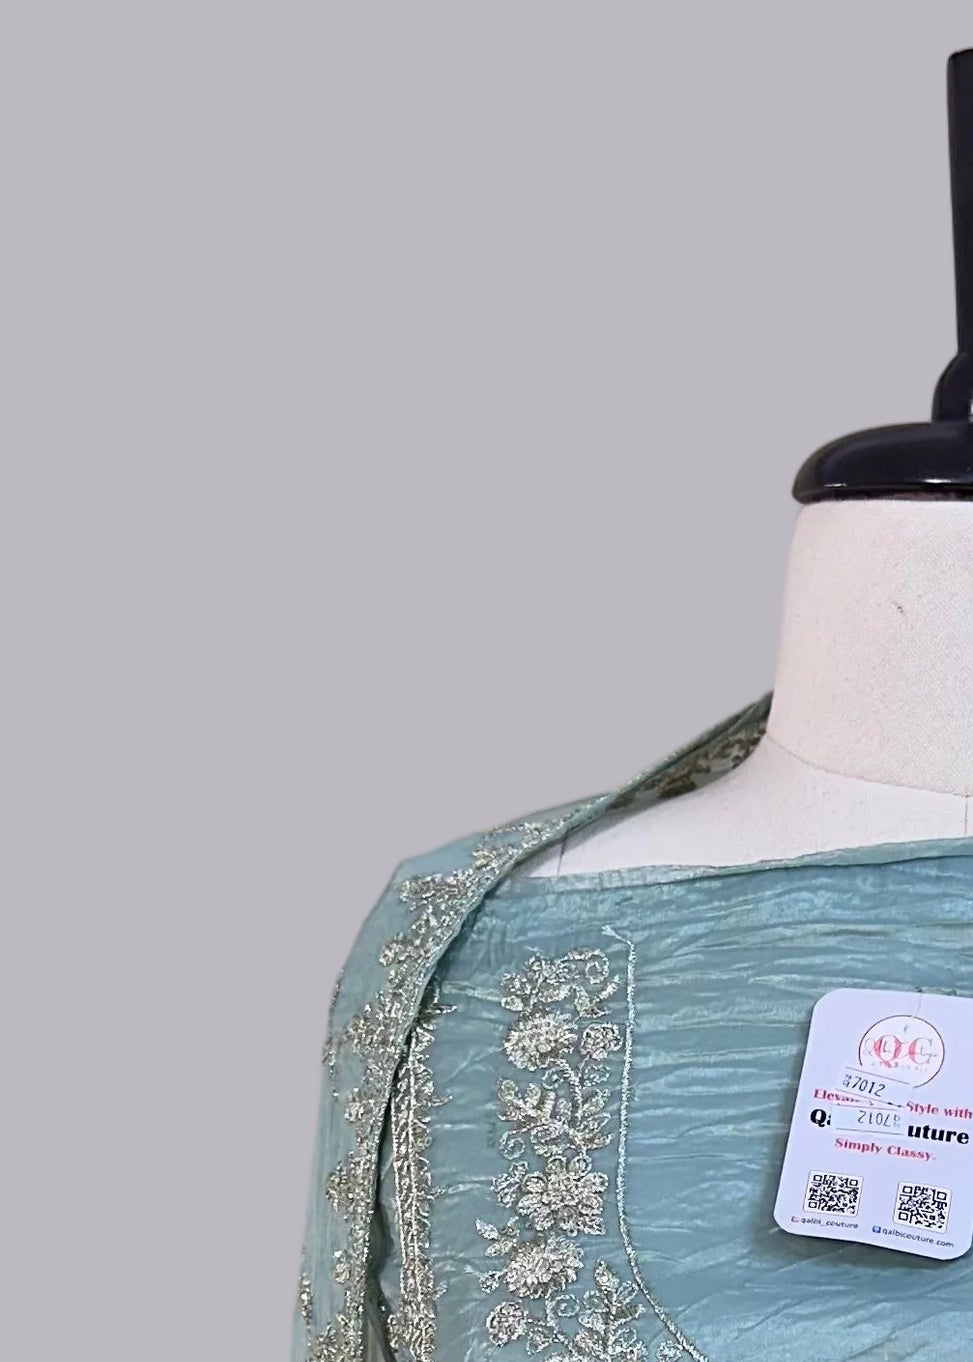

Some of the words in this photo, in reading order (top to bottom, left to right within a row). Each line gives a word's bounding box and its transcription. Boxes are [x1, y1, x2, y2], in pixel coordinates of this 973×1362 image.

[906, 1101, 939, 1115] Style
[944, 1107, 973, 1119] with
[834, 1138, 882, 1153] Simply
